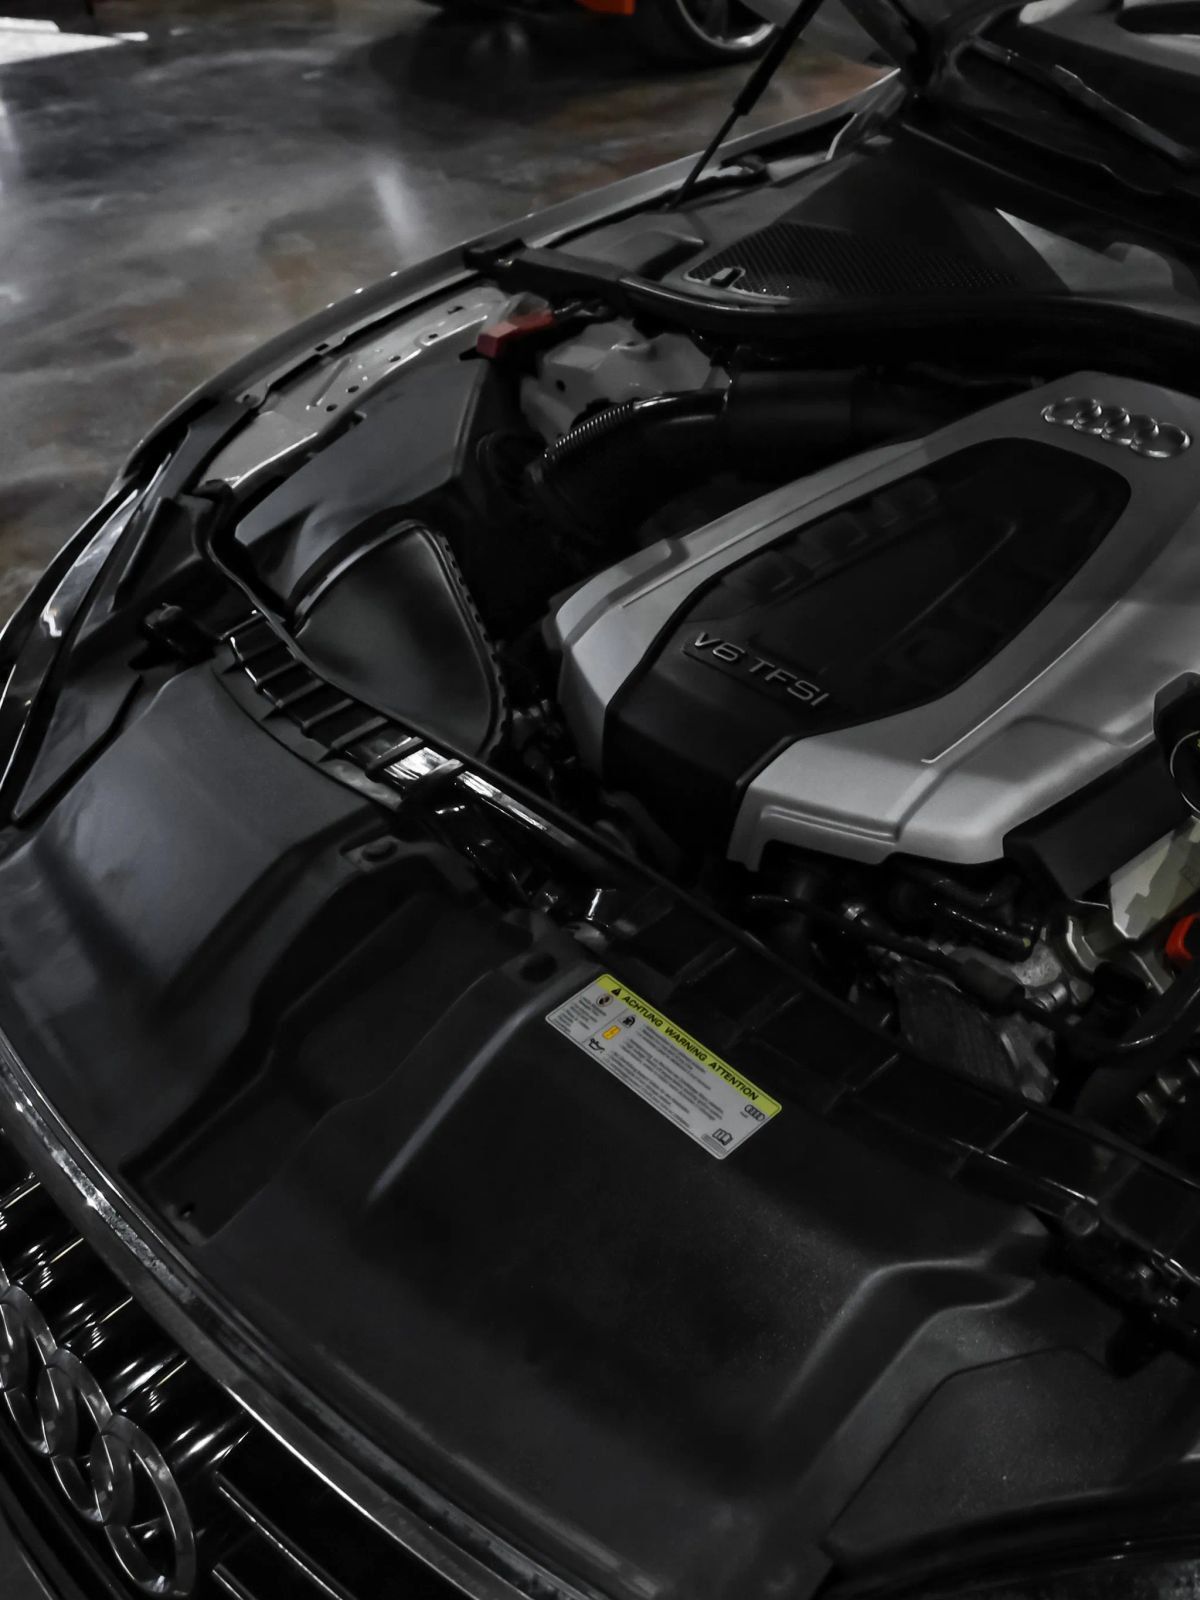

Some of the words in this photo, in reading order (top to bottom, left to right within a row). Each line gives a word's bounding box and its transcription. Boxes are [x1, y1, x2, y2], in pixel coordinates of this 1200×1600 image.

[694, 632, 746, 662] V6
[749, 657, 830, 706] TFSI
[622, 994, 664, 1029] ACHTUNG
[665, 1026, 708, 1062] WARNING
[708, 1060, 760, 1102] ATTENTION
